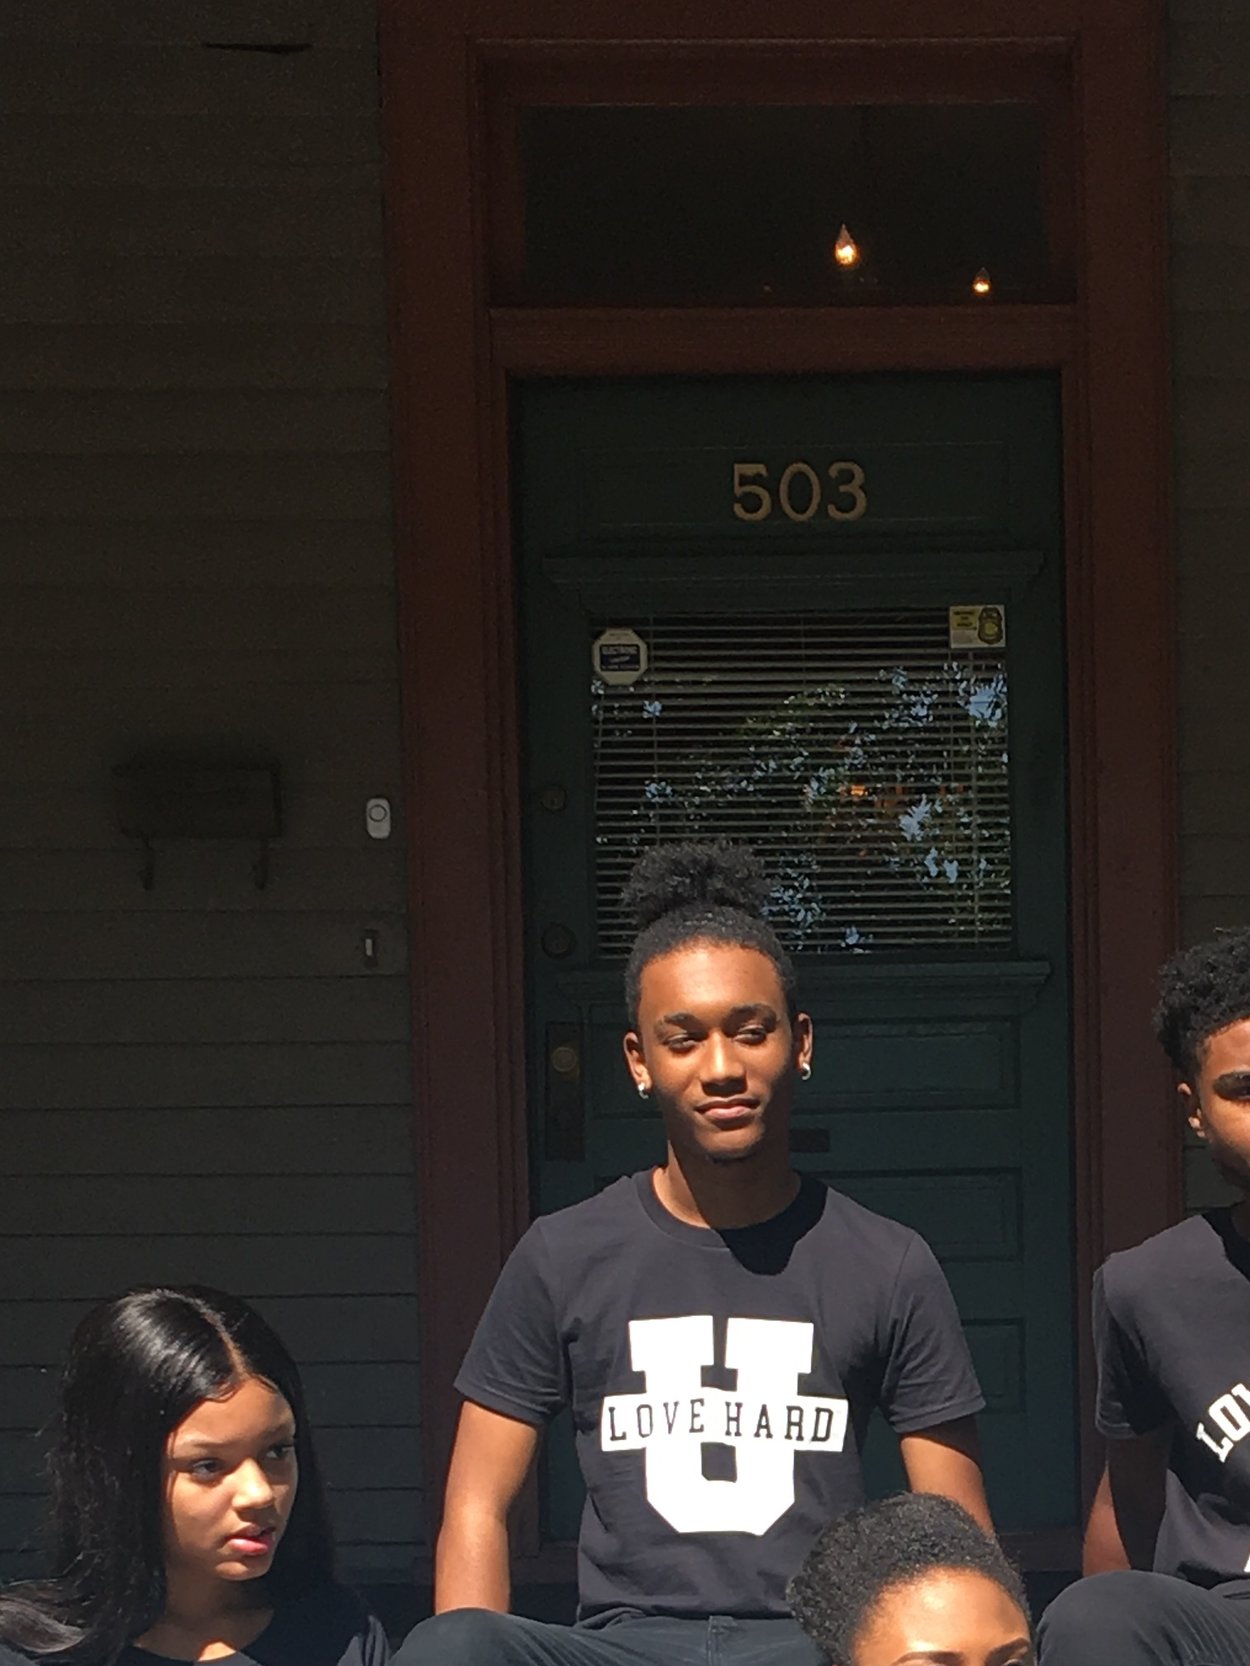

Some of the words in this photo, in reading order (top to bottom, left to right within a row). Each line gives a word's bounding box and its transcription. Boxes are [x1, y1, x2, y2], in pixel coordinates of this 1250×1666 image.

[733, 461, 868, 522] 503
[608, 1398, 705, 1441] LOVE
[724, 1401, 834, 1442] HARD
